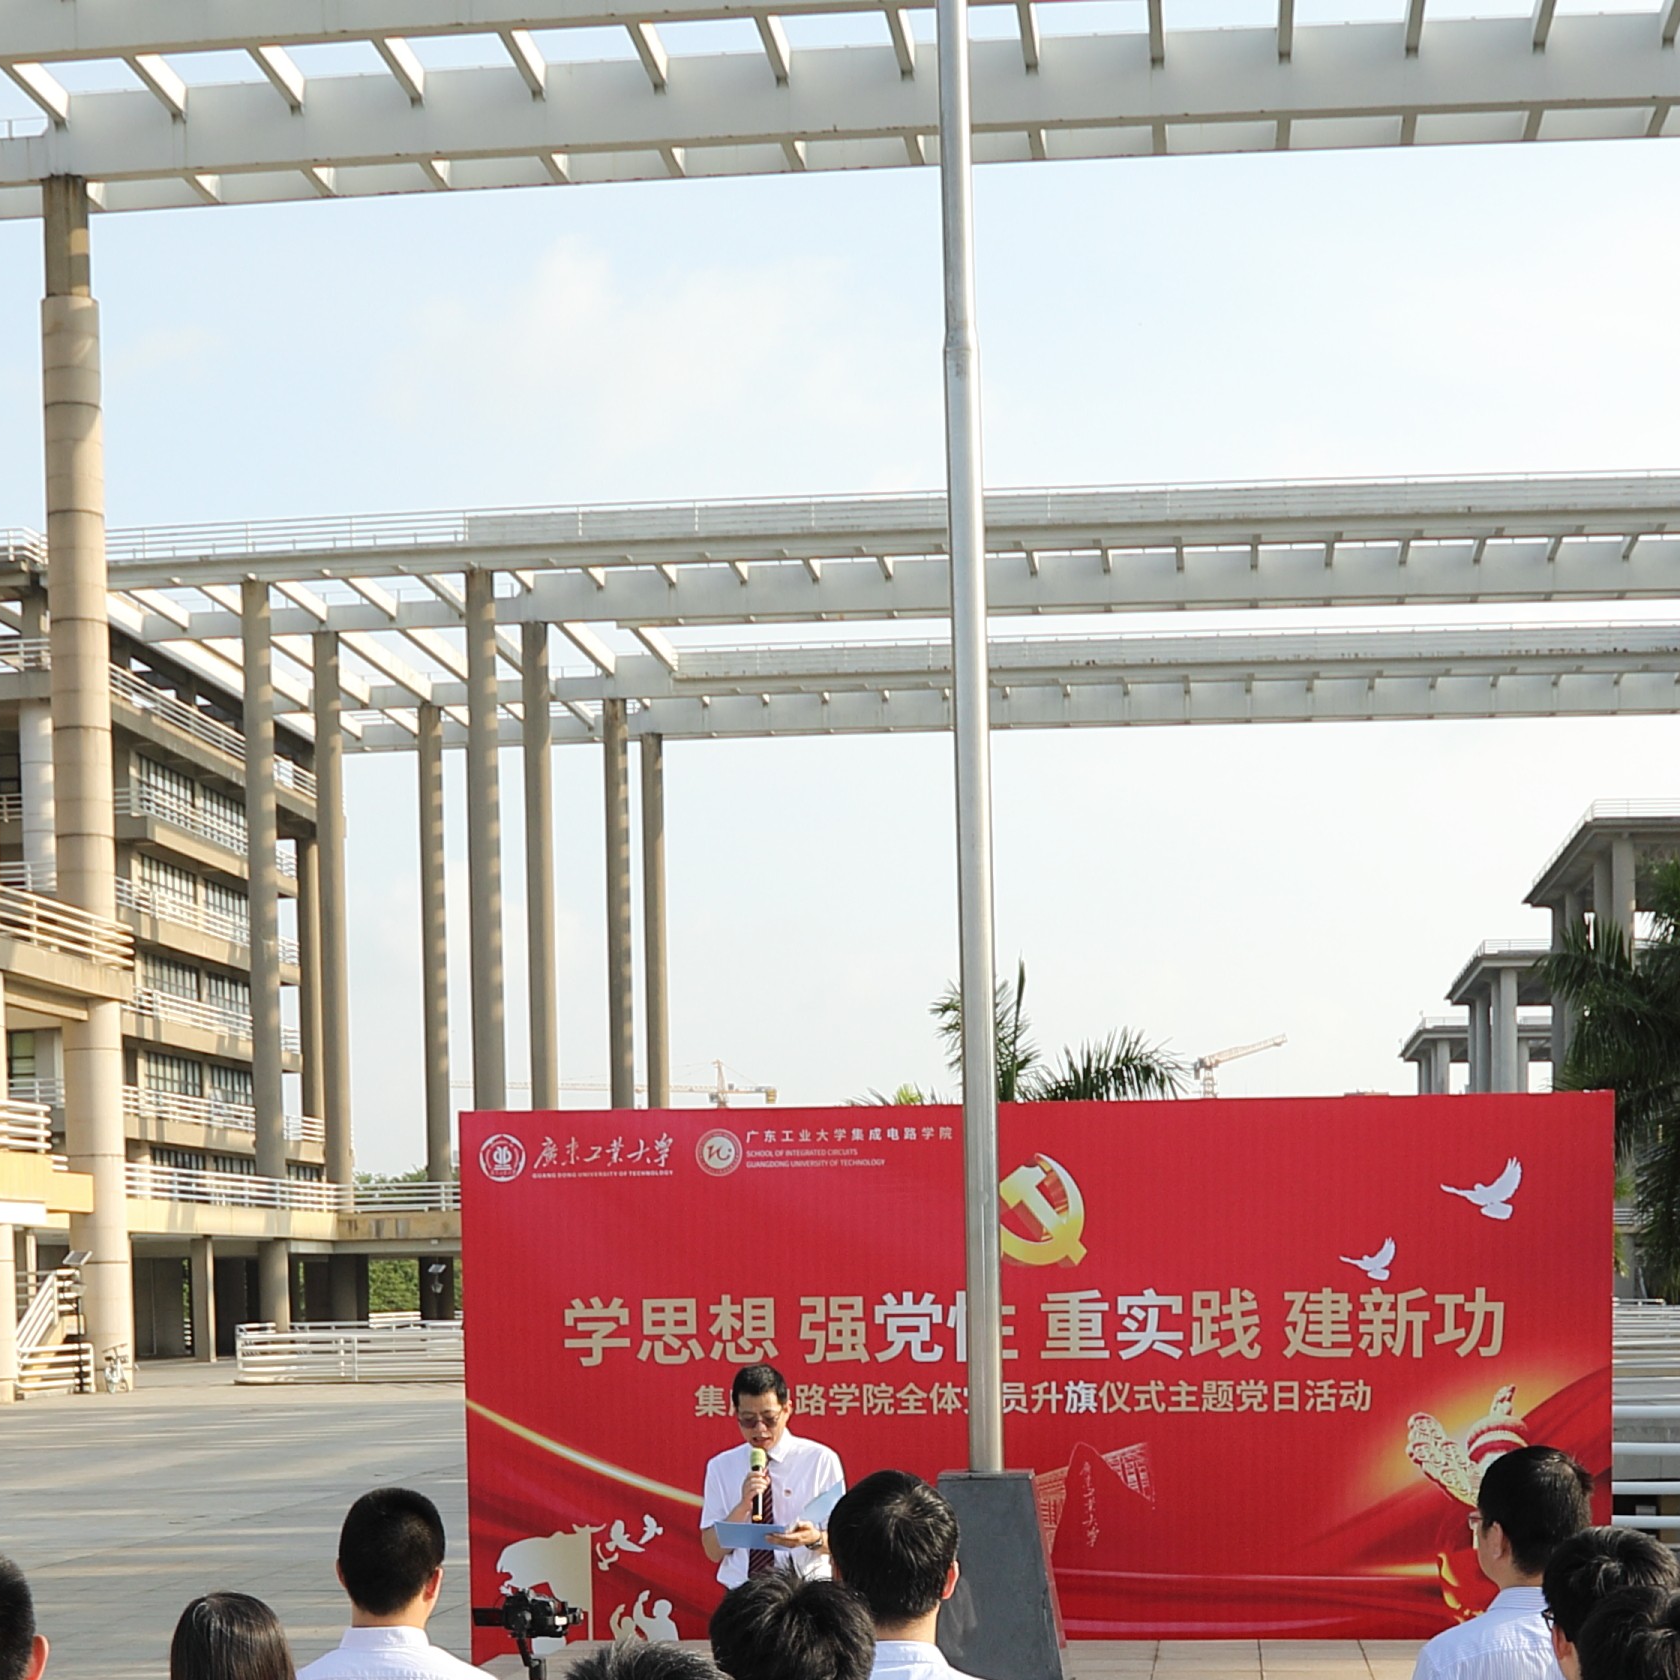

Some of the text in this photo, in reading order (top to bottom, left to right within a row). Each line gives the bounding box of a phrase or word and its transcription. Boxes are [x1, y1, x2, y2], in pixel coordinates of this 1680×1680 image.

[745, 1125, 954, 1144] 广东工业大学集成电路学院
[746, 1150, 774, 1158] SCHOOL
[785, 1149, 827, 1157] INTEGRATED
[827, 1148, 858, 1156] CIRCUITS
[790, 1160, 829, 1168] UNIVERSITY
[840, 1158, 886, 1167] TECHNOLOGY
[563, 1294, 780, 1367] 学思想
[1039, 1287, 1262, 1361] 重实践
[1282, 1286, 1506, 1359] 建新功
[694, 1379, 1372, 1418] 集路学院全体员升旗仪式主题党日活动
